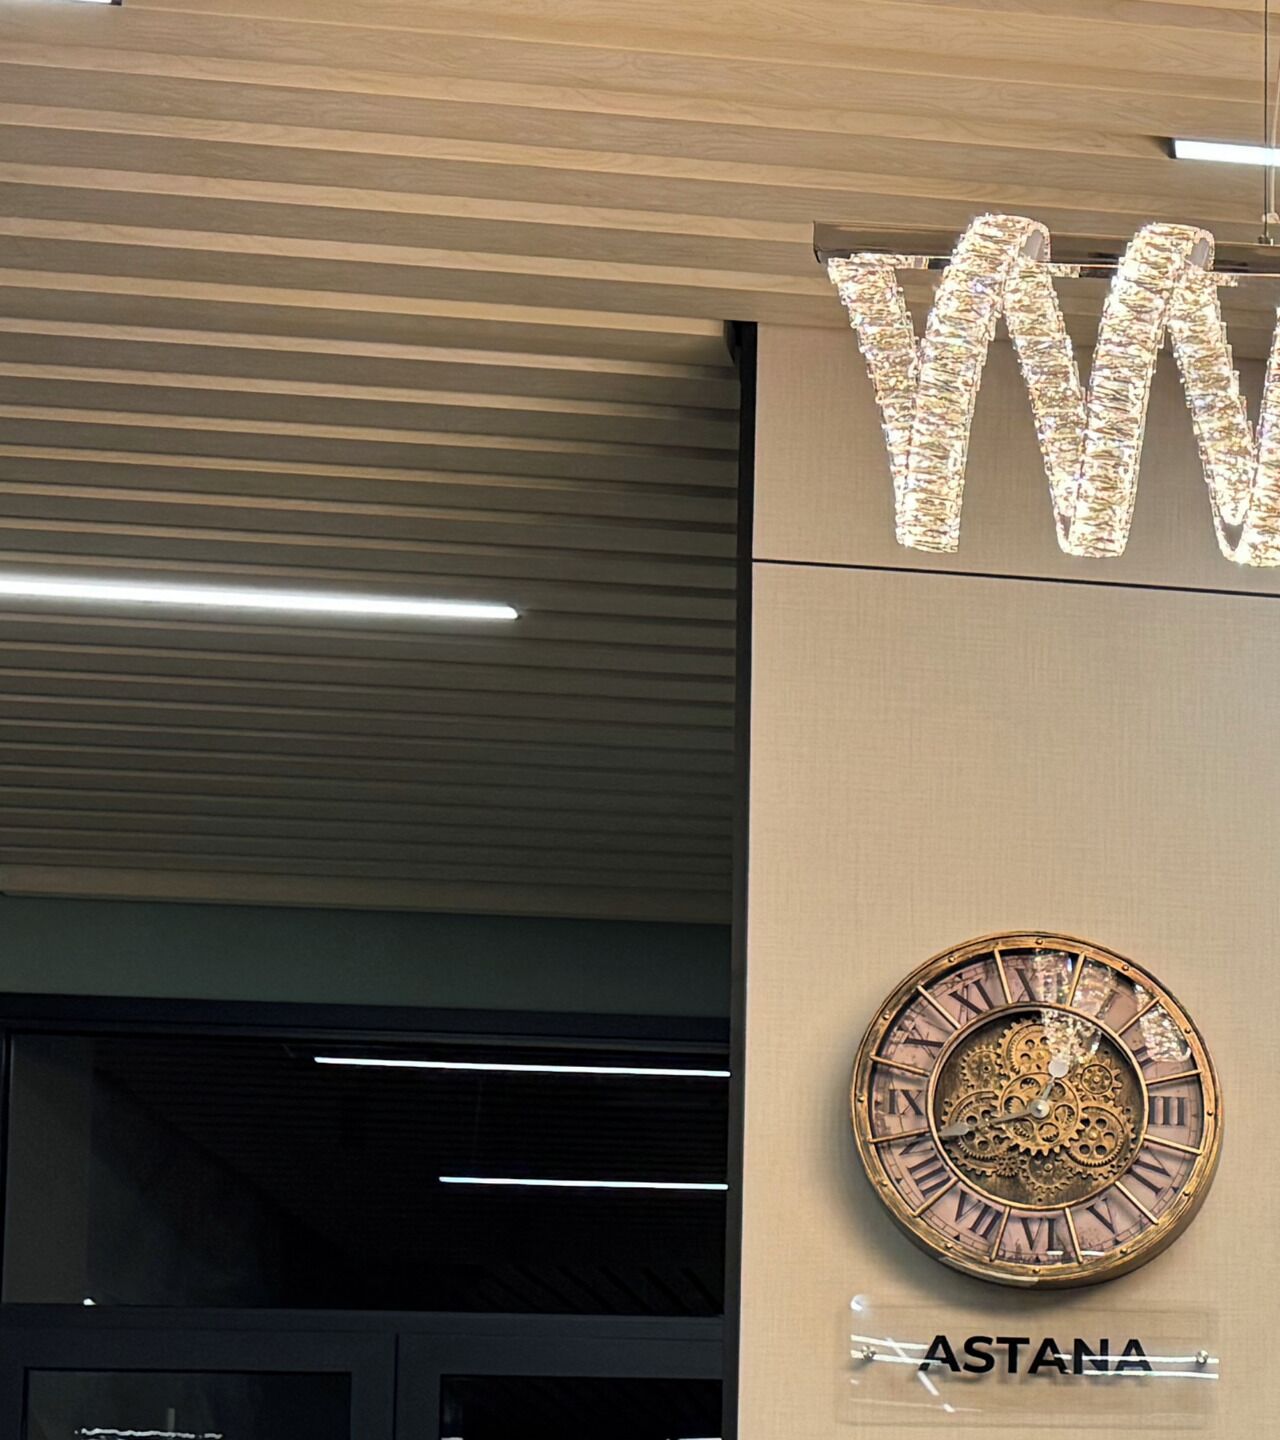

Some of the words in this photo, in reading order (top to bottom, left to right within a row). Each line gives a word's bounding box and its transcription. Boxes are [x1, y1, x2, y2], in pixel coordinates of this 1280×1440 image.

[888, 1089, 924, 1116] IX
[955, 1189, 1003, 1239] VII
[1086, 1199, 1117, 1234] V
[1020, 1217, 1056, 1251] VI
[918, 1335, 1153, 1375] ASTANA
